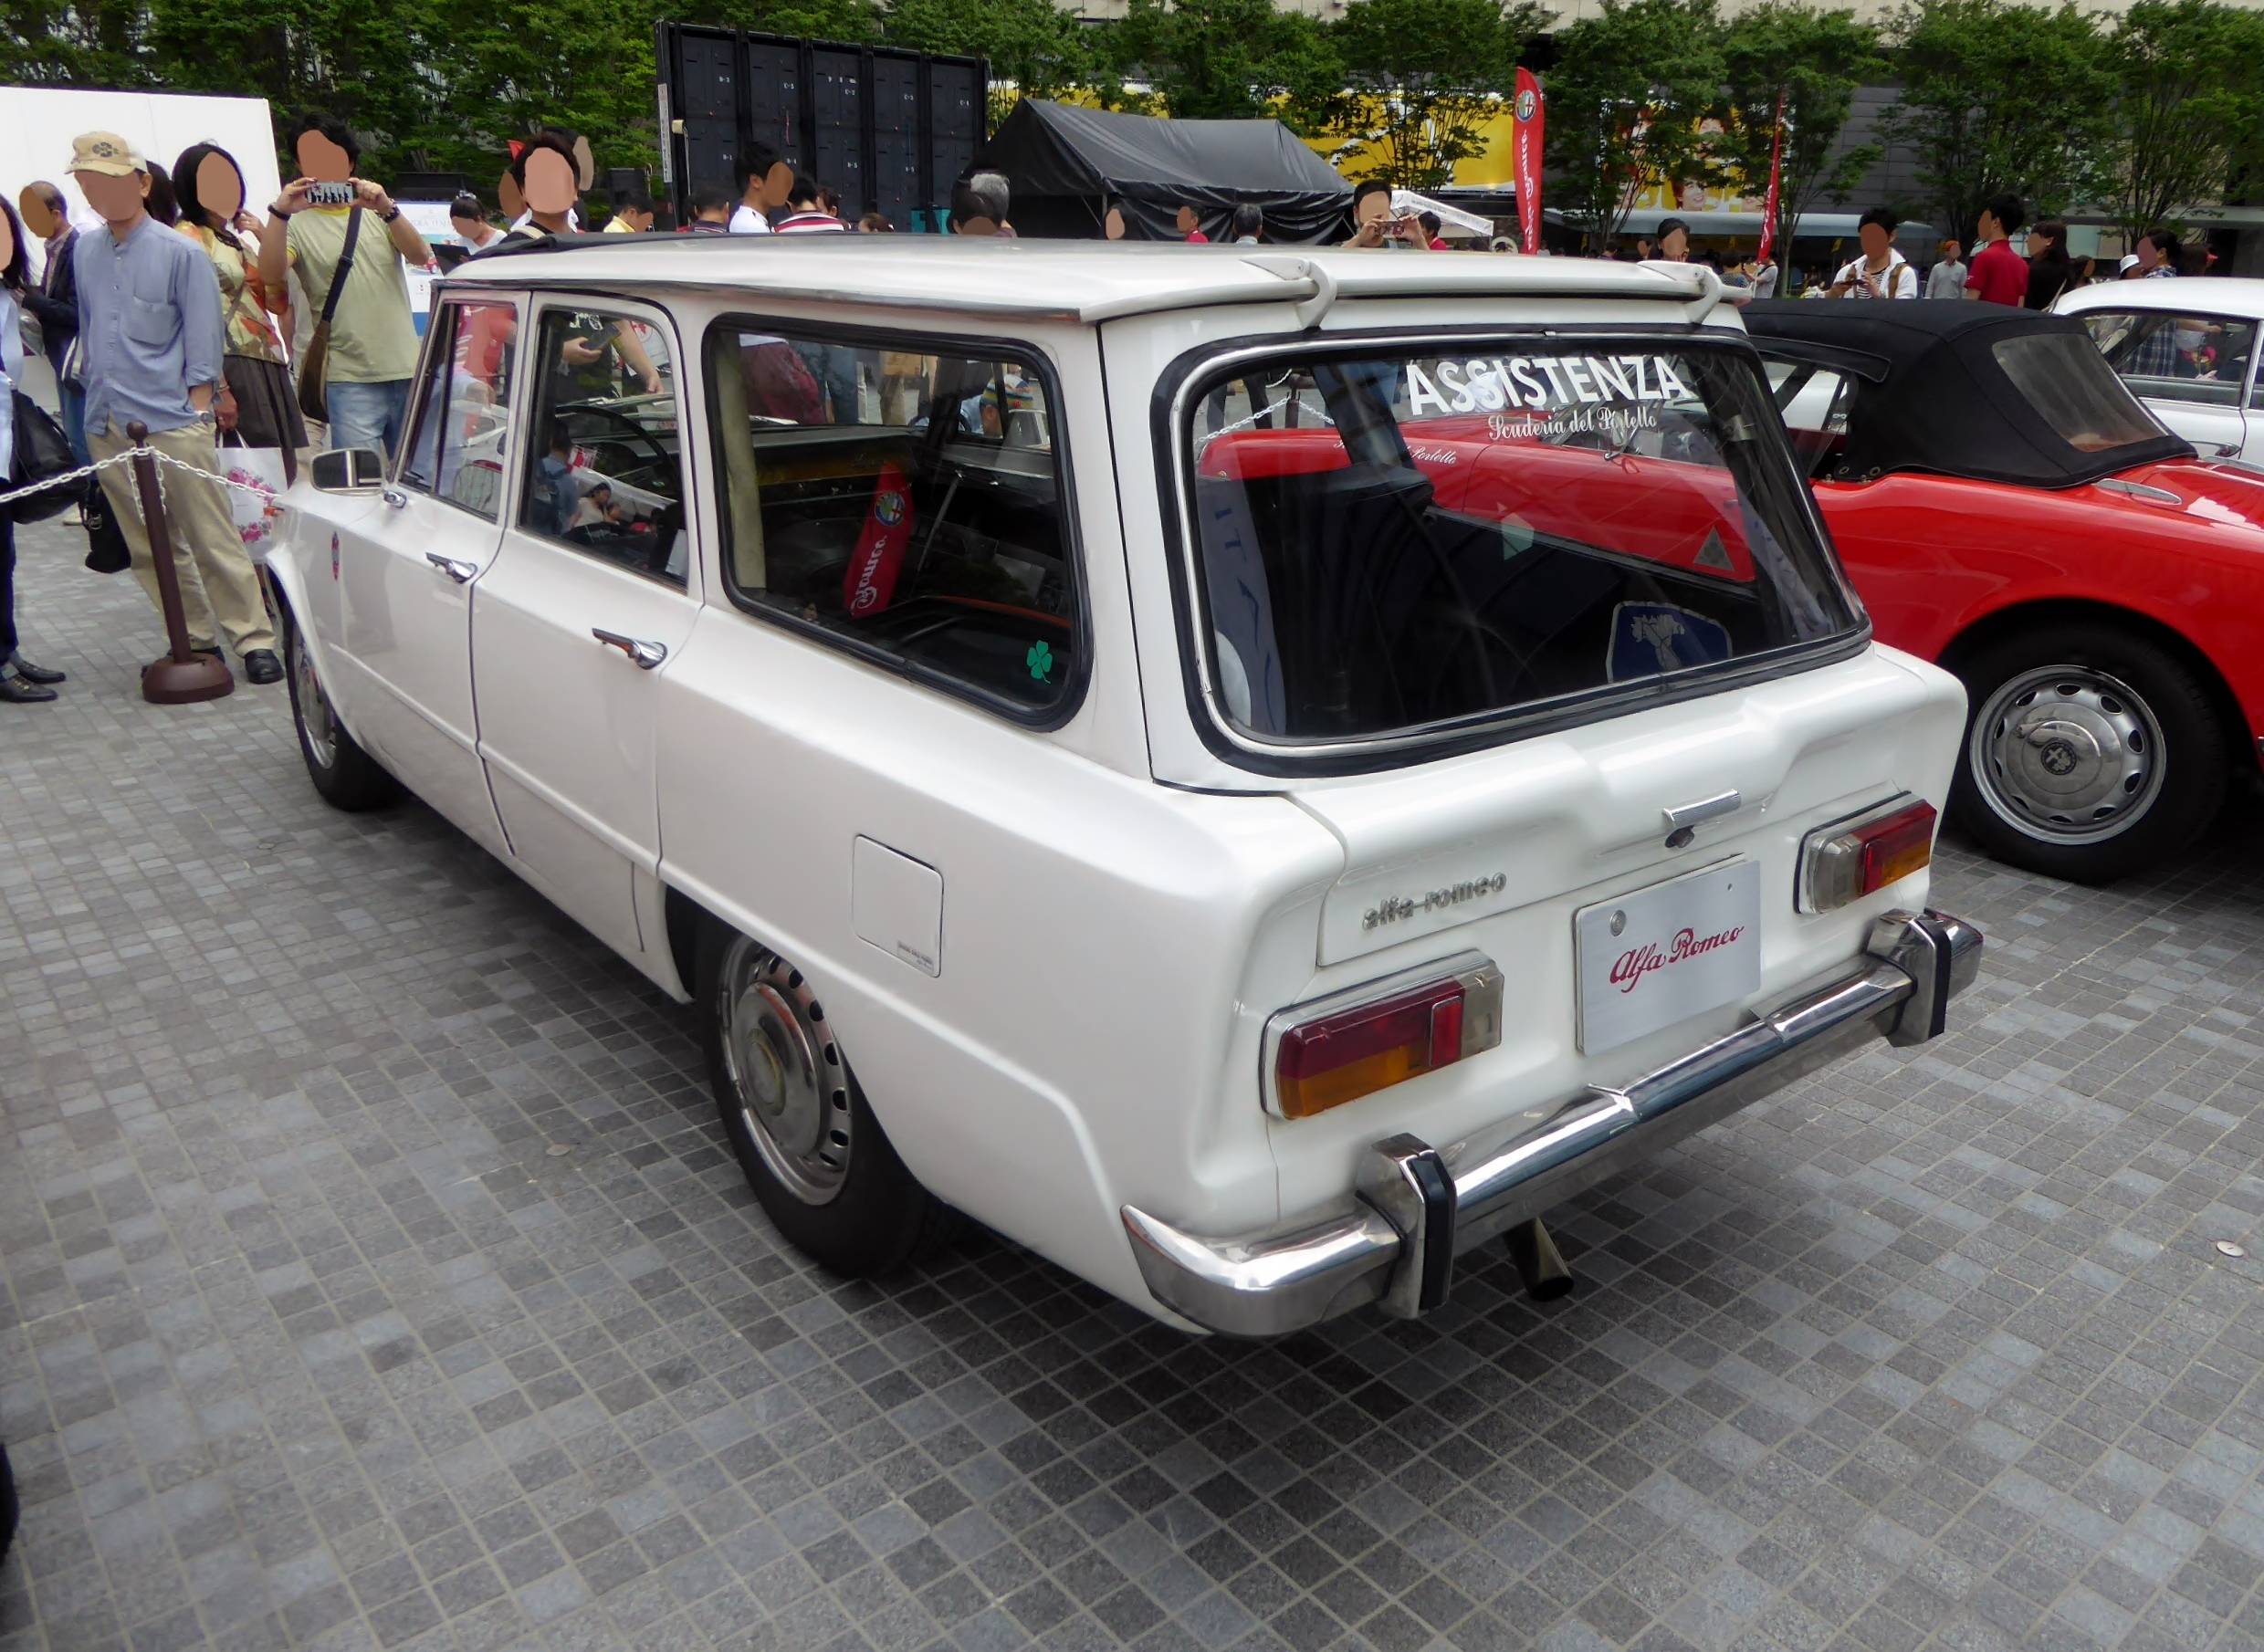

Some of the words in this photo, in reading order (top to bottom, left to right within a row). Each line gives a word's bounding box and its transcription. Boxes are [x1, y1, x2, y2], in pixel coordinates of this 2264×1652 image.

[1406, 356, 1693, 415] ASSISTENZA
[1489, 408, 1564, 441] Scuderia
[1569, 409, 1595, 434] del
[1597, 406, 1657, 430] Portello
[1609, 943, 1667, 993] Alfa
[1669, 926, 1745, 963] Romeo
